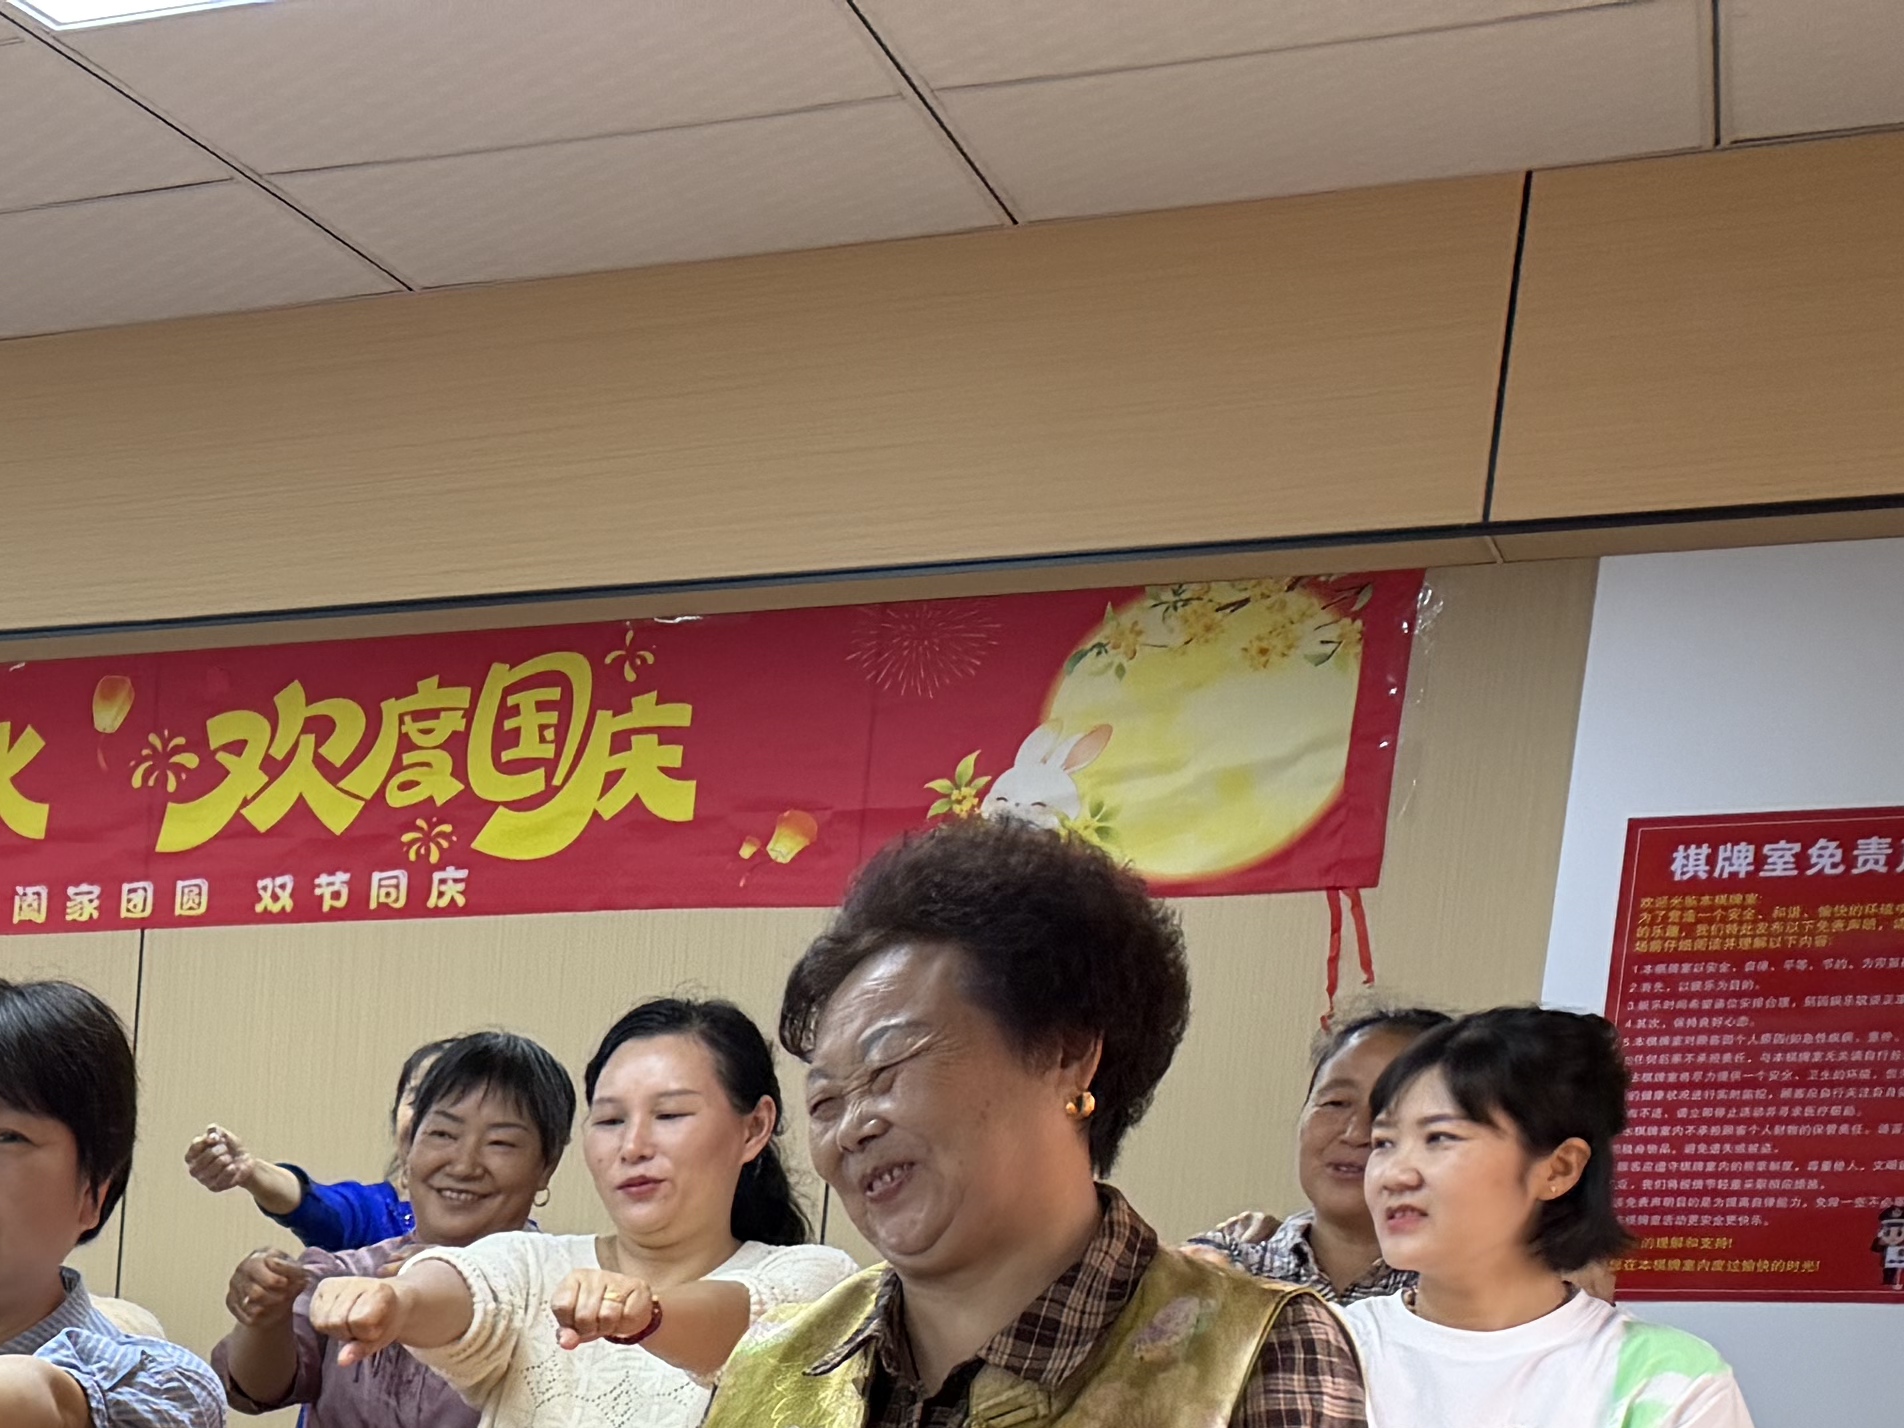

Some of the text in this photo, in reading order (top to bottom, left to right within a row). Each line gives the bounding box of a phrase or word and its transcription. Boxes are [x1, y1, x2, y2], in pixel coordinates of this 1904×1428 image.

[155, 651, 696, 861] 欢度国庆
[1670, 836, 1904, 882] 棋牌室免责
[13, 878, 209, 925] 阖家团圆
[255, 865, 469, 914] 双节同庆
